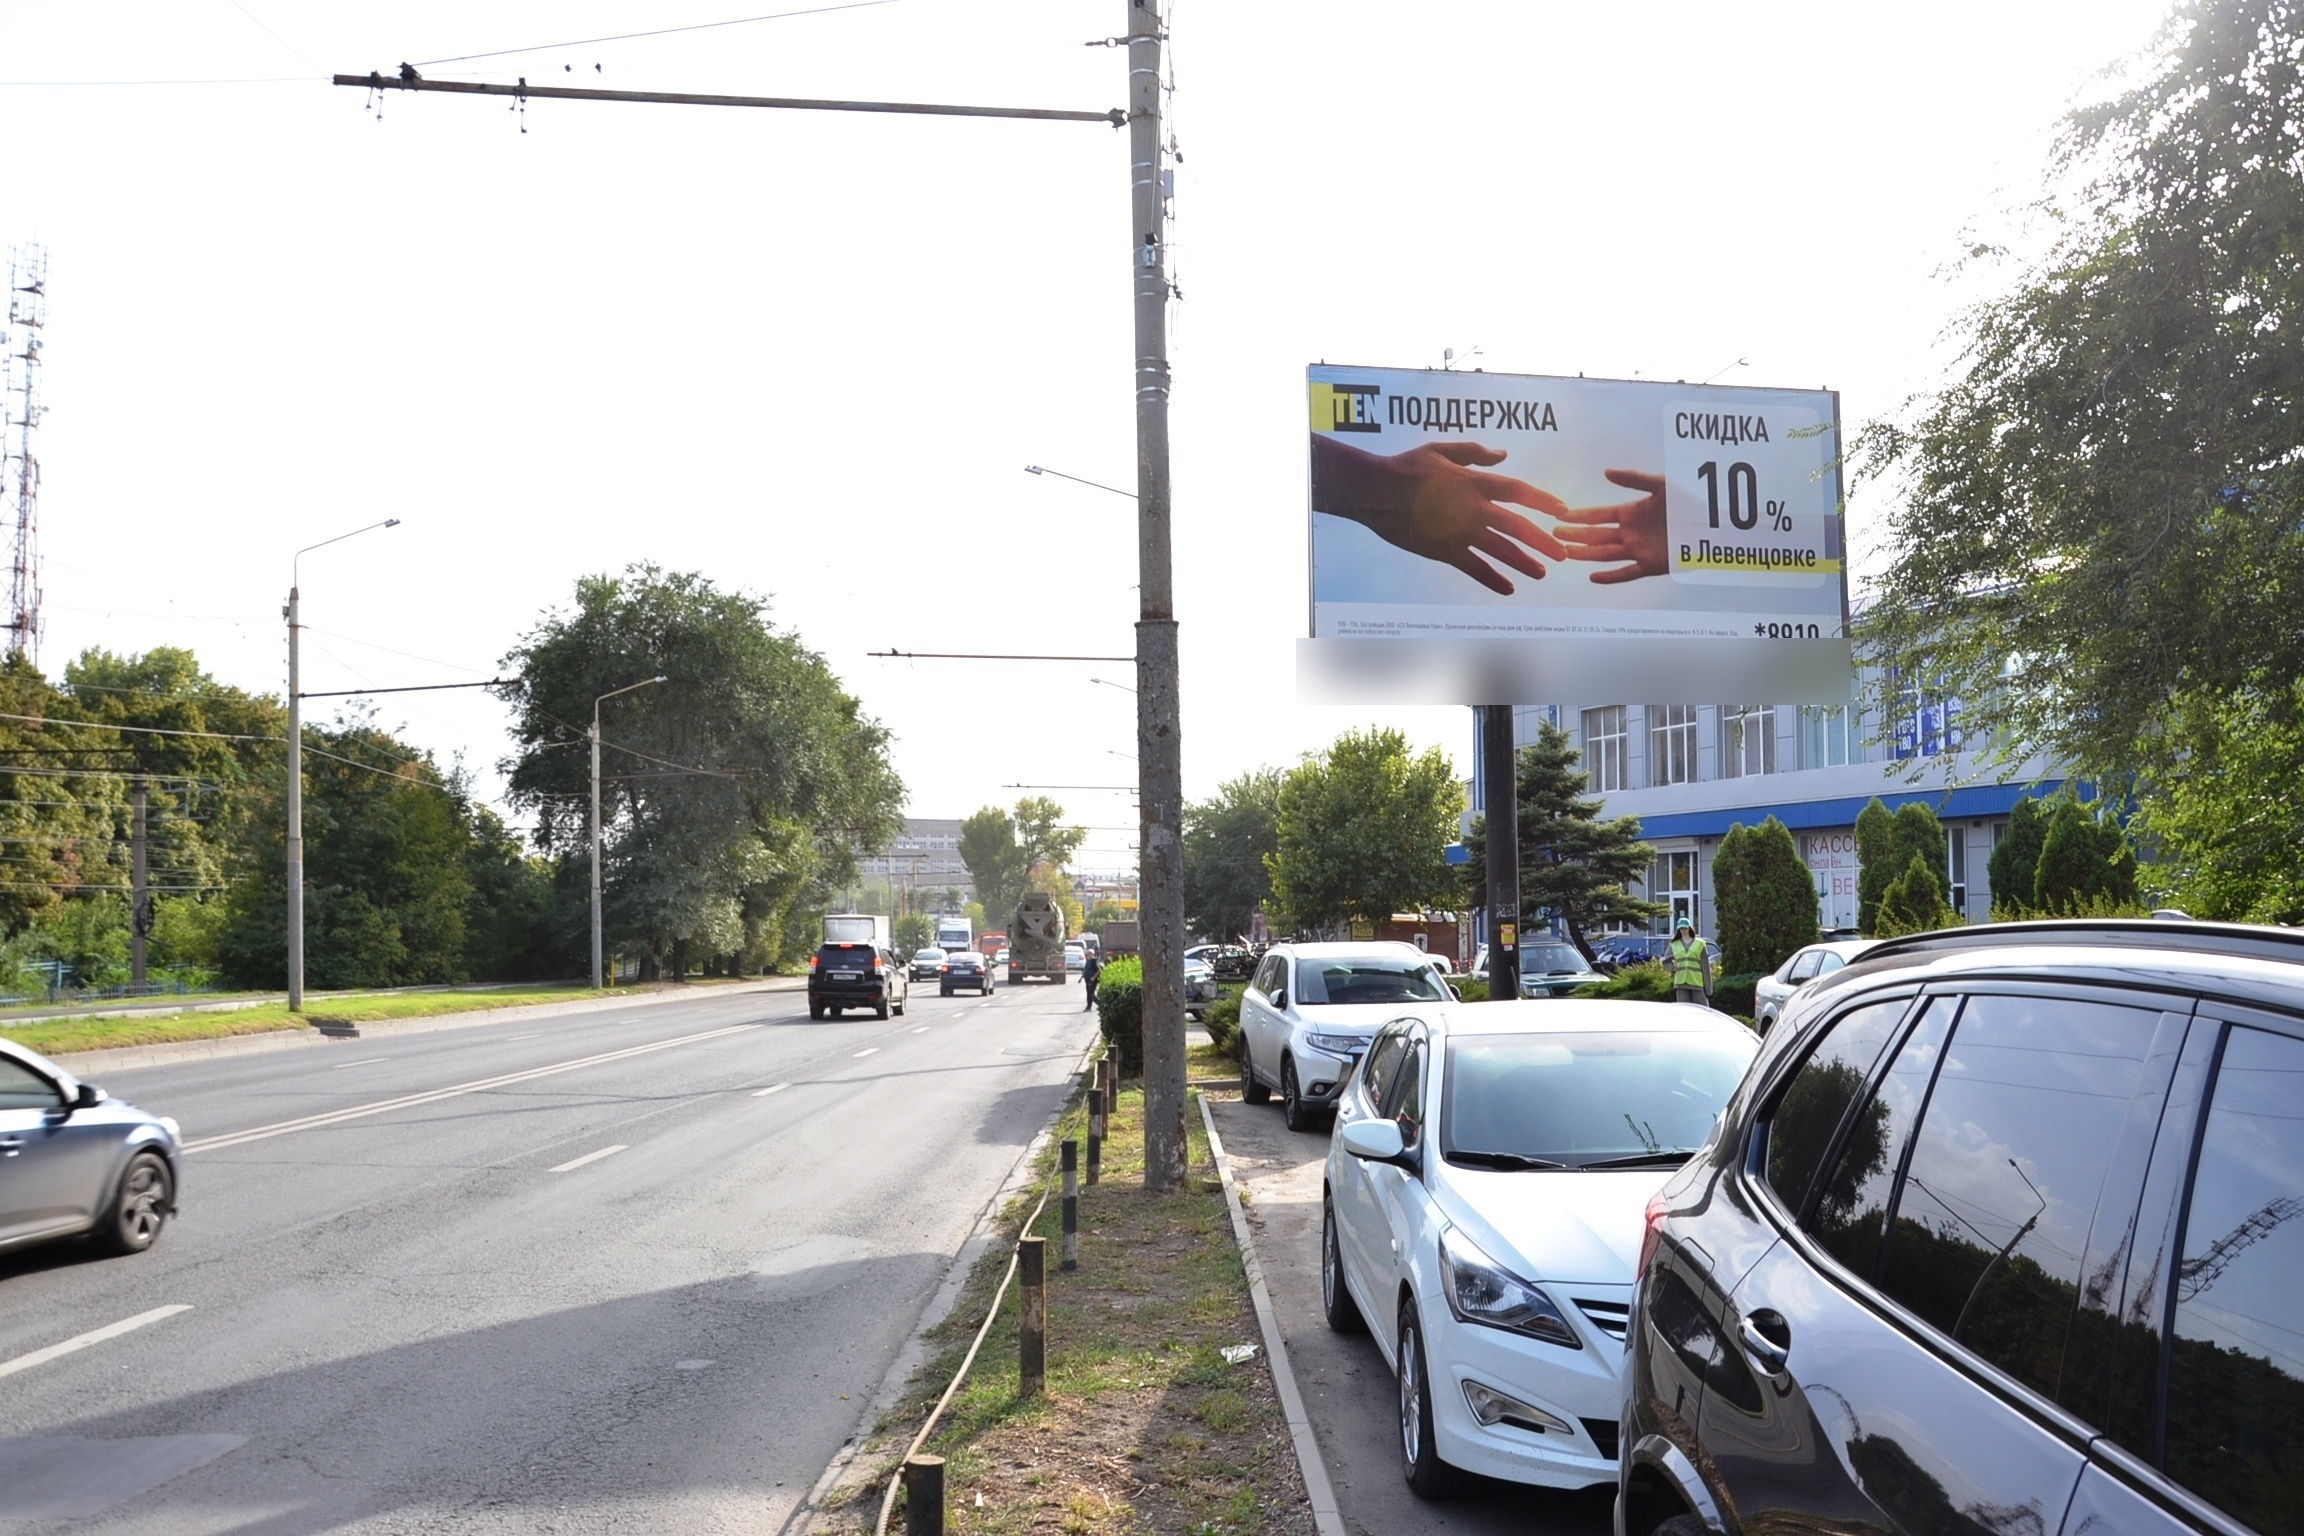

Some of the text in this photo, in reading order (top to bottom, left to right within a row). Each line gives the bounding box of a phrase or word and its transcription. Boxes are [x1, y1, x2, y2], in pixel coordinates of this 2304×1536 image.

[1333, 387, 1379, 429] TEN
[1388, 395, 1558, 433] ПОДДЕРЖКА
[1675, 411, 1770, 446] СКИДКА
[1697, 461, 1758, 531] 10
[1680, 539, 1816, 570] в Левенцовке
[1810, 857, 1842, 868] онлайн
